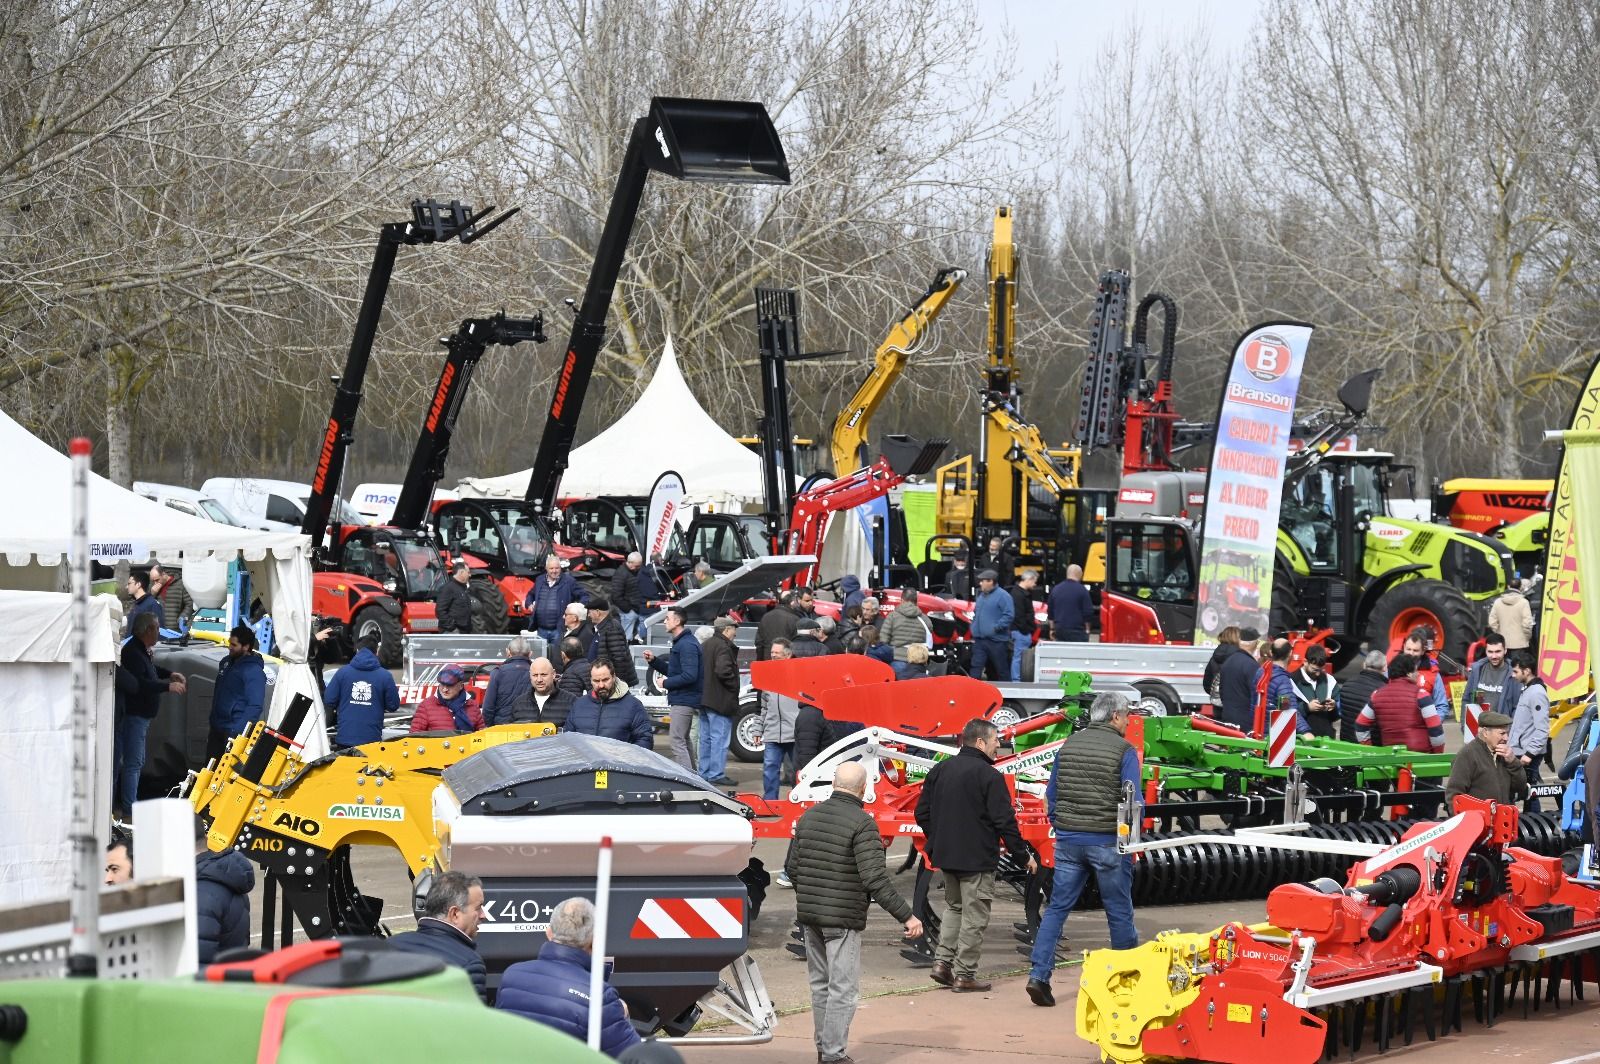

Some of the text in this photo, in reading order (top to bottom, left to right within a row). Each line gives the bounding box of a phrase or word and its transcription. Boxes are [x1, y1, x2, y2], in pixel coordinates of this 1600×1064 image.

[1256, 345, 1278, 371] B
[426, 361, 456, 433] MANITOU
[552, 350, 576, 420] MANITOU
[1231, 383, 1289, 406] Branson
[1229, 416, 1279, 447] CALIDAD E
[313, 417, 339, 495] MANITOU
[1219, 481, 1269, 511] AL MEJOR
[1222, 514, 1259, 541] PRECIO
[1543, 528, 1567, 614] TALLER
[1537, 785, 1563, 796] MEVISA
[273, 812, 319, 836] AIO
[348, 805, 402, 820] MEVISA
[251, 838, 283, 852] AIO
[1242, 950, 1262, 959] LION
